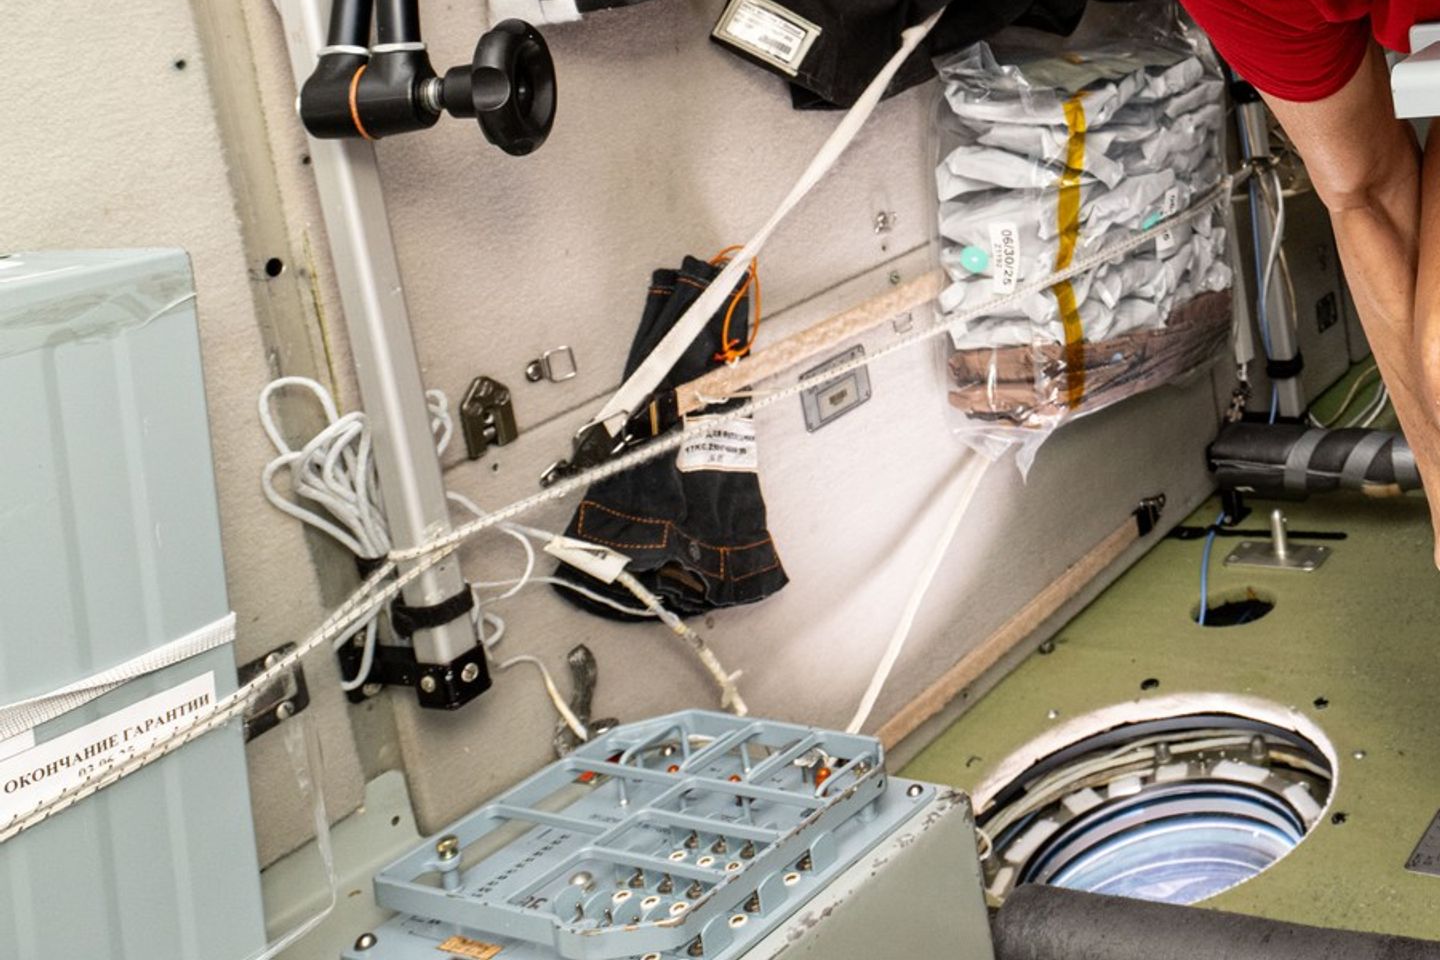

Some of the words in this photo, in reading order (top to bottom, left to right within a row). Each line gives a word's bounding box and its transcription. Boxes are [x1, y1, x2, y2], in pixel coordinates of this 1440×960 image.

[1001, 229, 1015, 285] 06/30/25
[4, 734, 119, 794] ОКОНЧАНИЕ
[123, 693, 210, 741] ГАРАНТИИ
